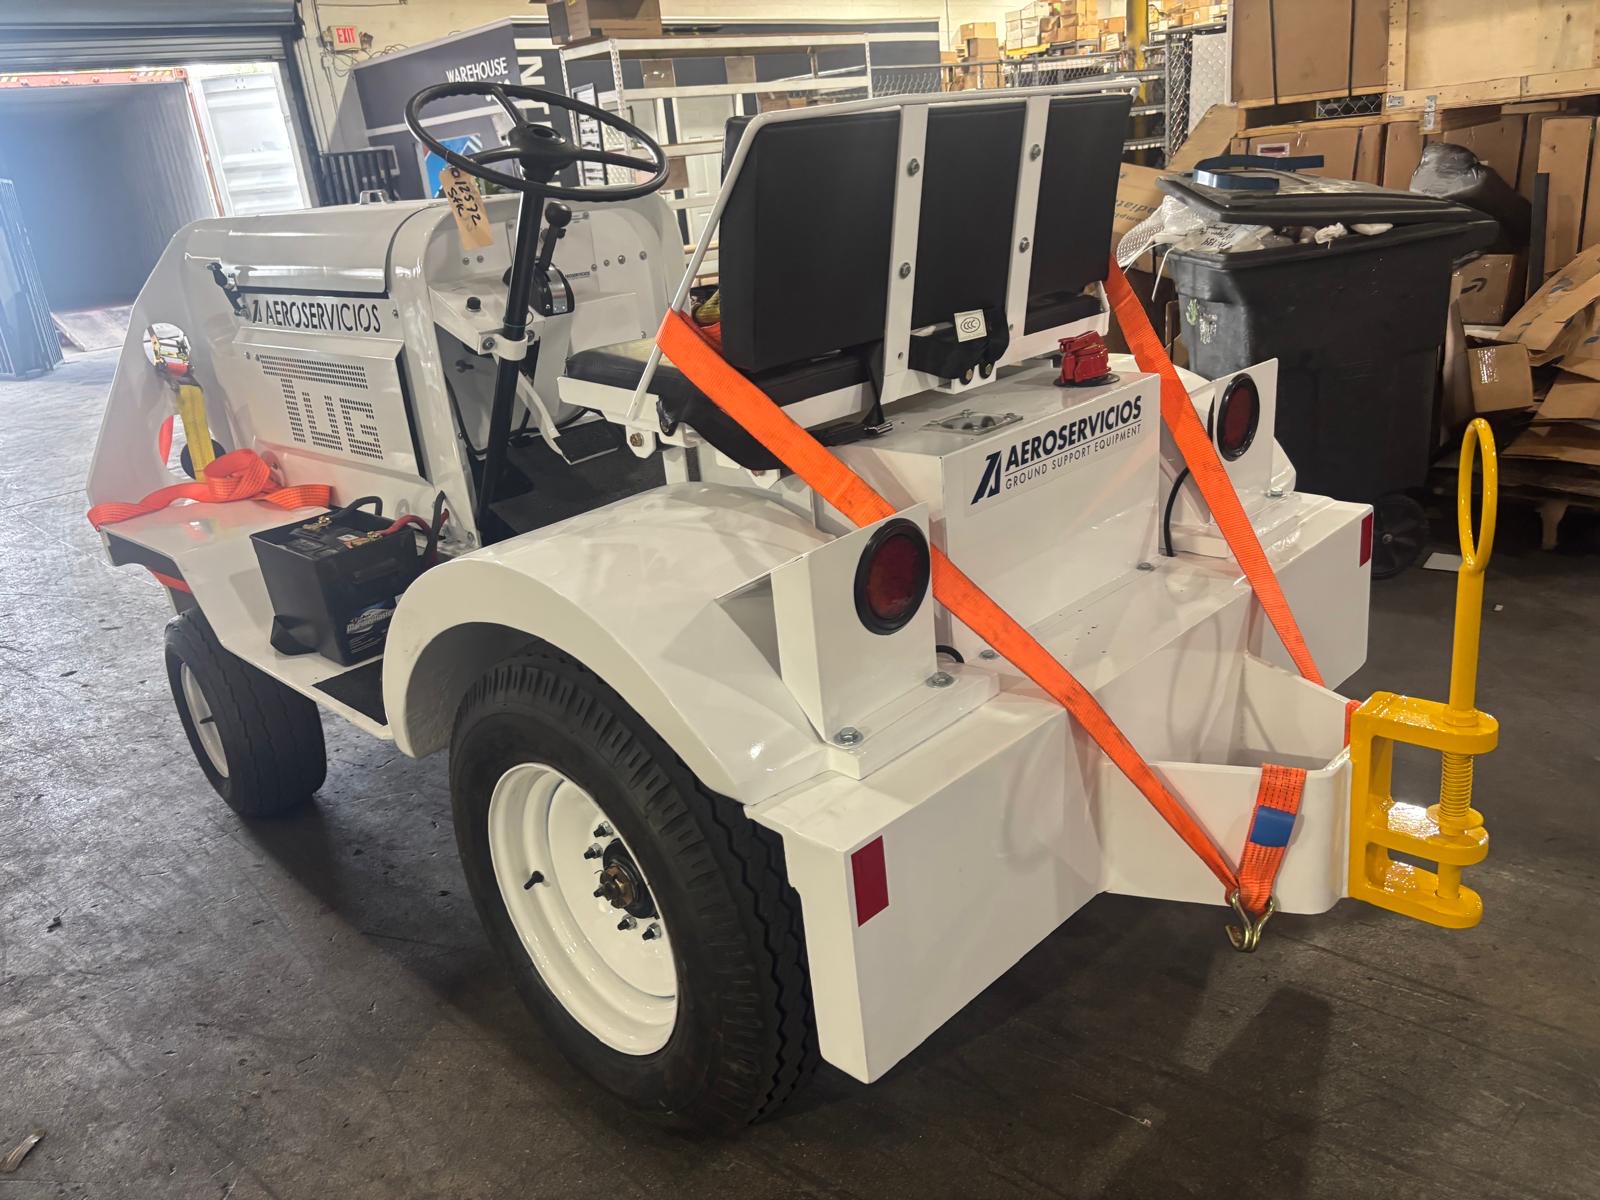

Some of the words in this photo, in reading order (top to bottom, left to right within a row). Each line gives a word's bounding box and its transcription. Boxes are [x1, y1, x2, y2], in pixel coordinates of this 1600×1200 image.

[336, 28, 356, 43] EXIT
[445, 57, 509, 83] WAREHOUSE
[266, 300, 381, 333] AEROSERVICIOS
[1005, 395, 1142, 472] AEROSERVICIOS
[1005, 463, 1048, 490] GROUND
[1051, 446, 1091, 471] SUPPORT
[1094, 423, 1142, 453] EQUIPMENT
